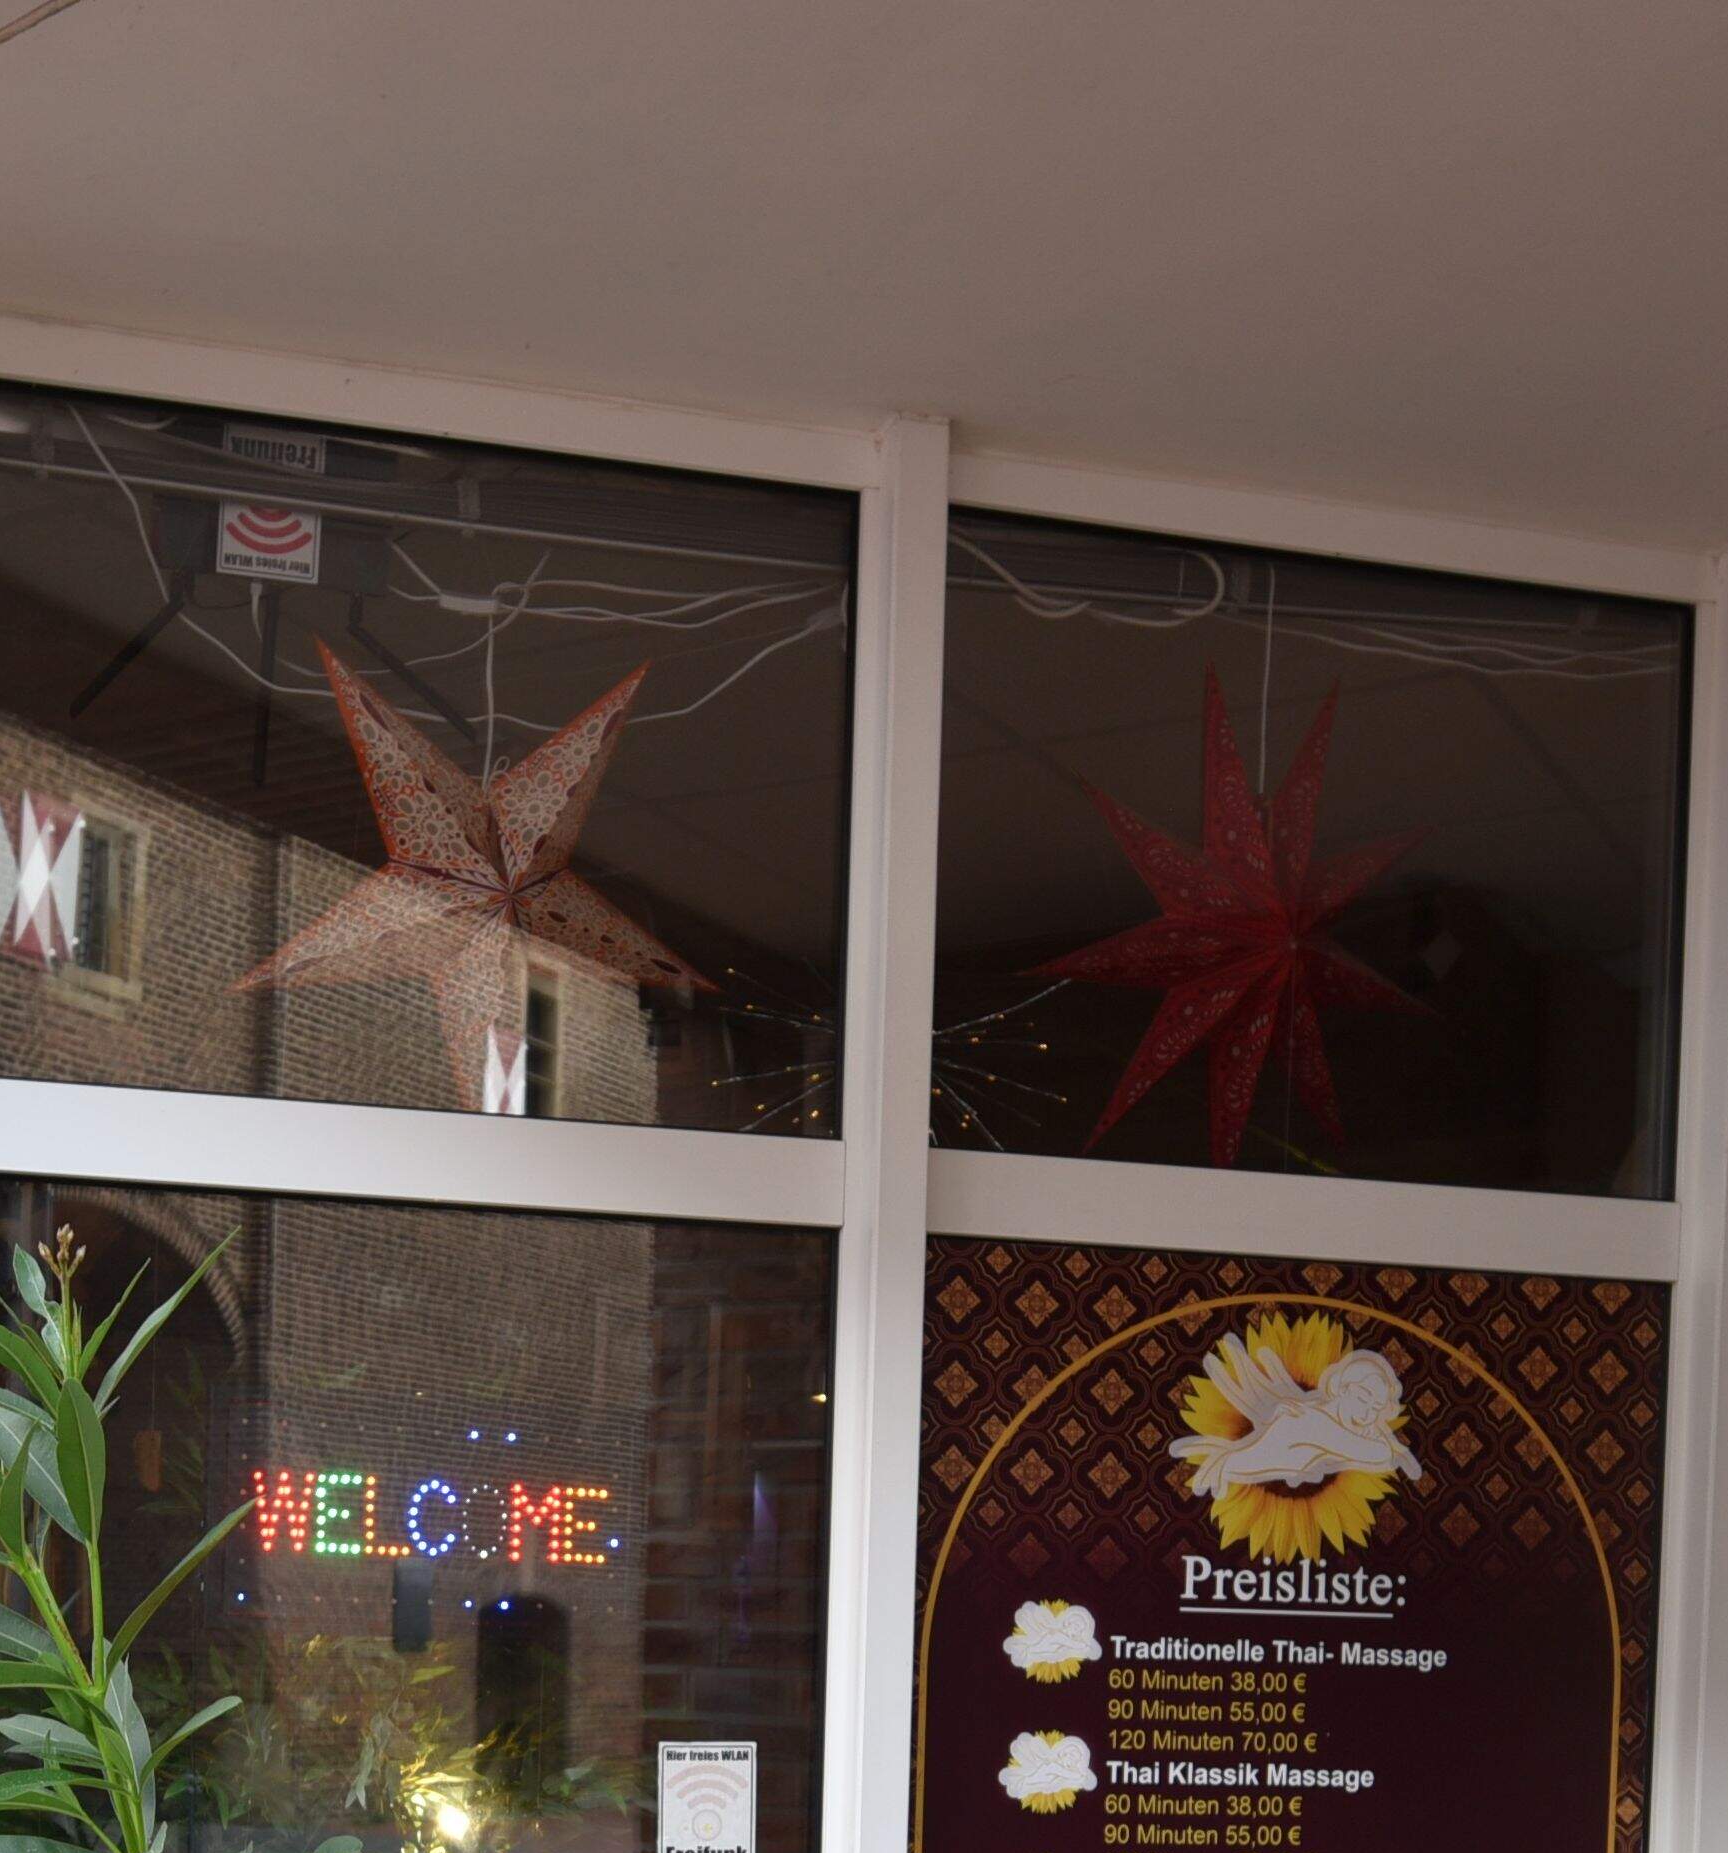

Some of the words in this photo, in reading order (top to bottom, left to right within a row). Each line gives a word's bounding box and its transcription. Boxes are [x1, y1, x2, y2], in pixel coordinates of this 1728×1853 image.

[253, 1470, 609, 1564] WELCOME
[1179, 1555, 1407, 1608] Preisliste:
[1110, 1635, 1264, 1662] Traditionelle
[1272, 1640, 1334, 1664] Thai-
[1341, 1642, 1447, 1672] Massage
[1109, 1669, 1134, 1689] 60
[1142, 1670, 1223, 1691] Minuten
[1231, 1672, 1287, 1694] 38,00
[1293, 1673, 1306, 1693] €
[1108, 1699, 1133, 1719] 90
[1142, 1700, 1222, 1721] Minuten
[1230, 1702, 1286, 1724] 55,00
[1292, 1703, 1305, 1723] €
[1109, 1729, 1145, 1749] 120
[1153, 1730, 1233, 1751] Minuten
[1242, 1732, 1297, 1754] 70,00
[1304, 1732, 1317, 1752] €
[666, 1750, 687, 1761] Hier
[689, 1750, 719, 1761] freies
[721, 1750, 749, 1761] WLAN
[1106, 1761, 1159, 1784] Thai
[1168, 1762, 1259, 1785] Klassik
[1267, 1763, 1374, 1793] Massage
[1104, 1794, 1130, 1814] 60
[1138, 1794, 1219, 1815] Minuten
[1227, 1796, 1283, 1818] 38,00
[1289, 1796, 1302, 1816] €
[1104, 1824, 1129, 1844] 90
[1137, 1824, 1218, 1845] Minuten
[1226, 1825, 1282, 1848] 55,00
[1288, 1826, 1301, 1845] €
